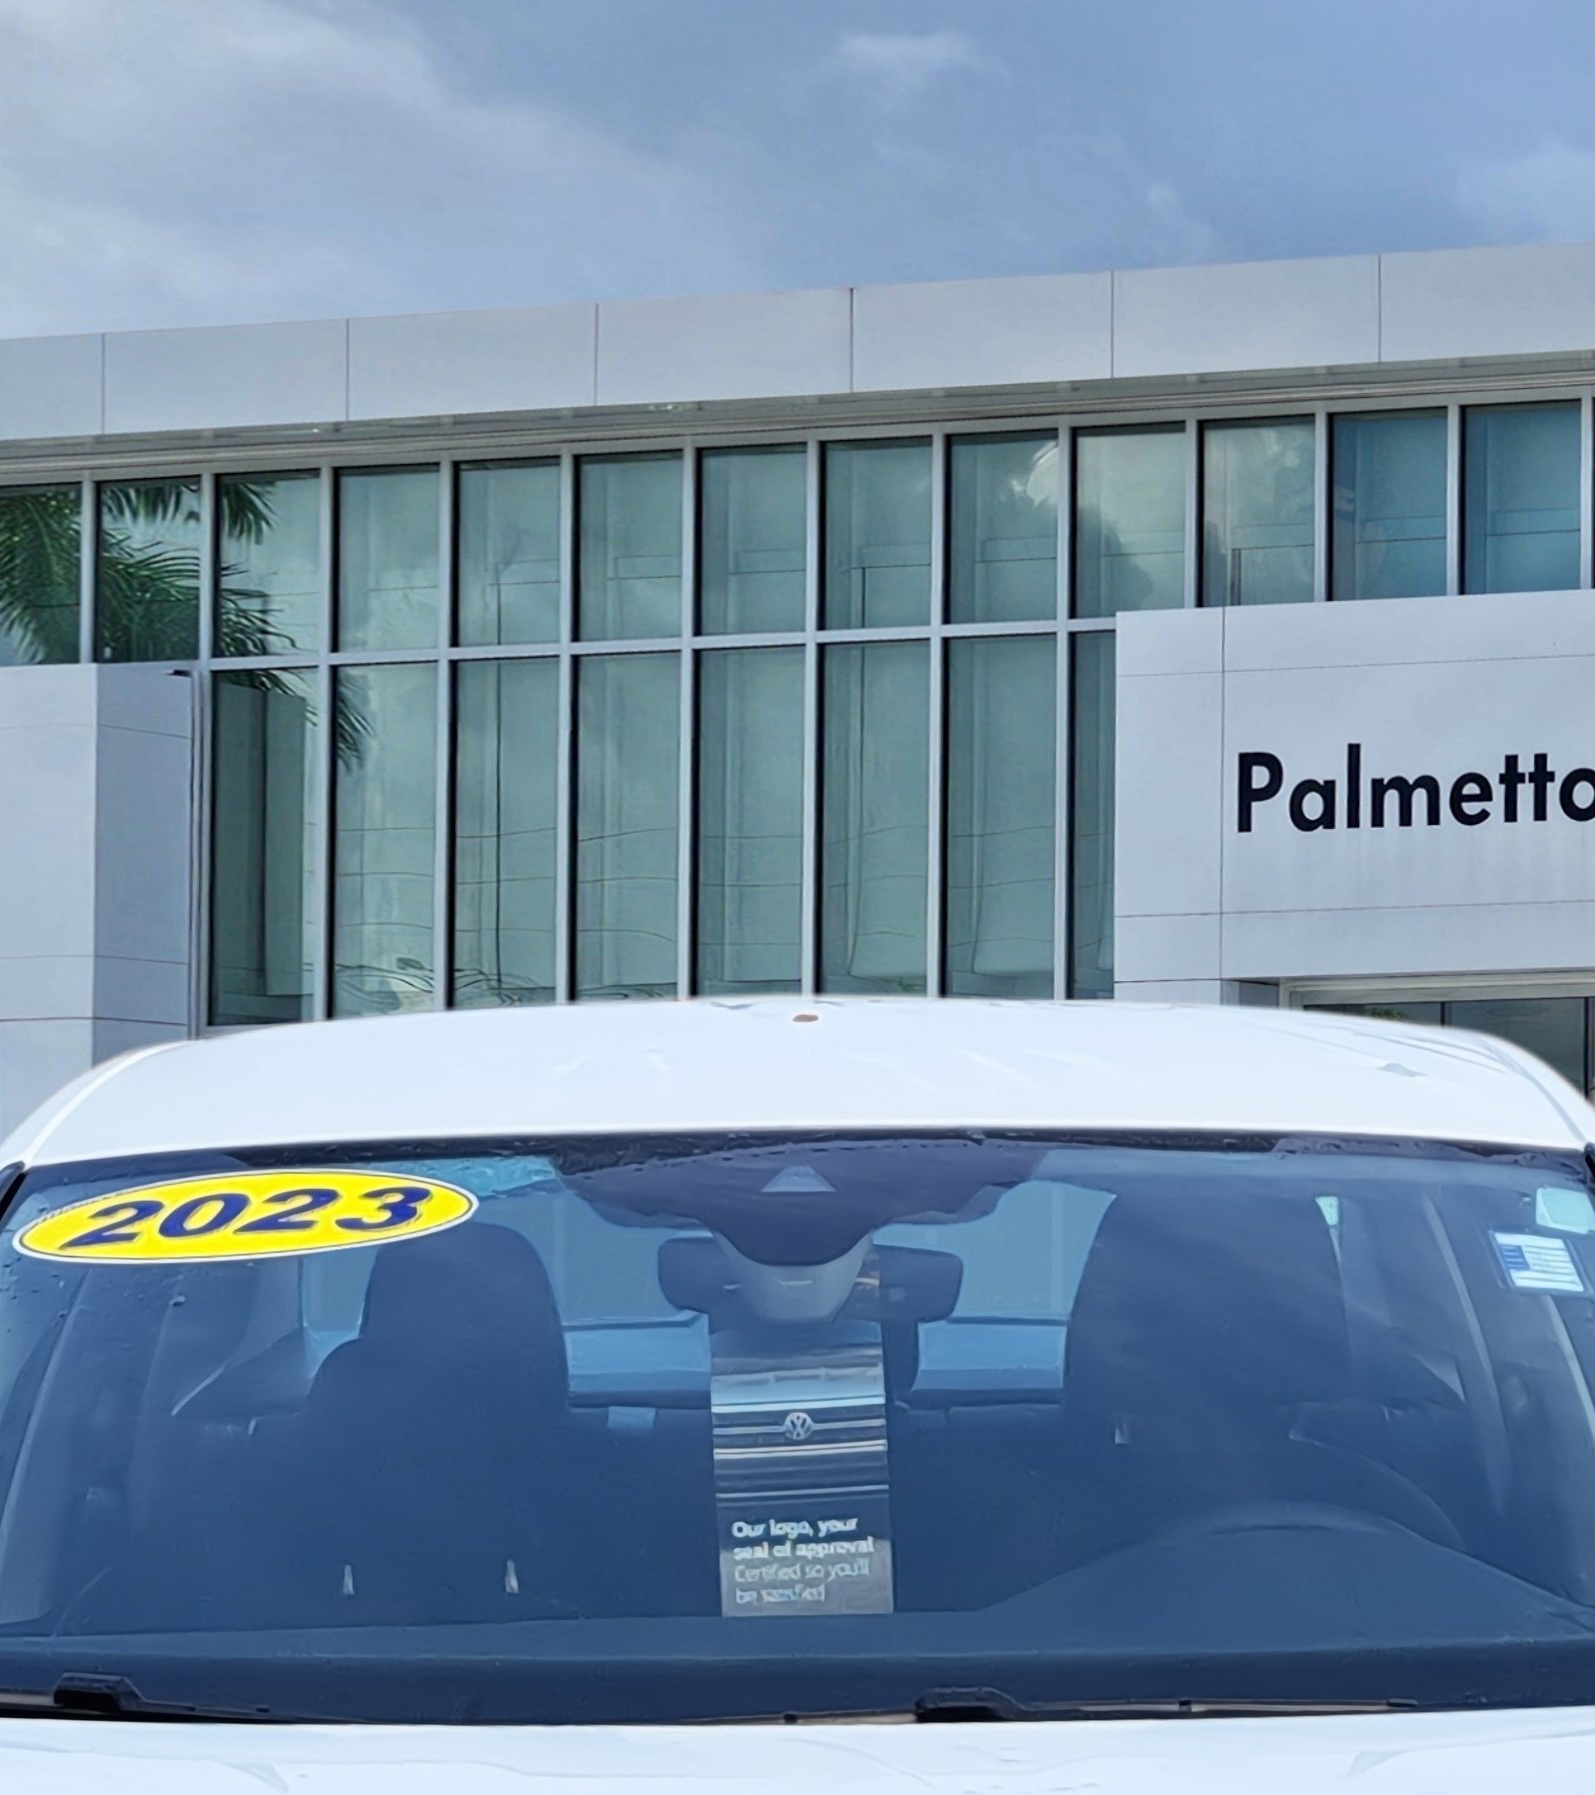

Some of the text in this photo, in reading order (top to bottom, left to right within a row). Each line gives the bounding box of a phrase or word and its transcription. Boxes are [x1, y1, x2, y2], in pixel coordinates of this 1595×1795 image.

[59, 1186, 432, 1250] 2023
[732, 1521, 766, 1537] Our
[818, 1518, 858, 1537] your
[796, 1536, 874, 1559] approval
